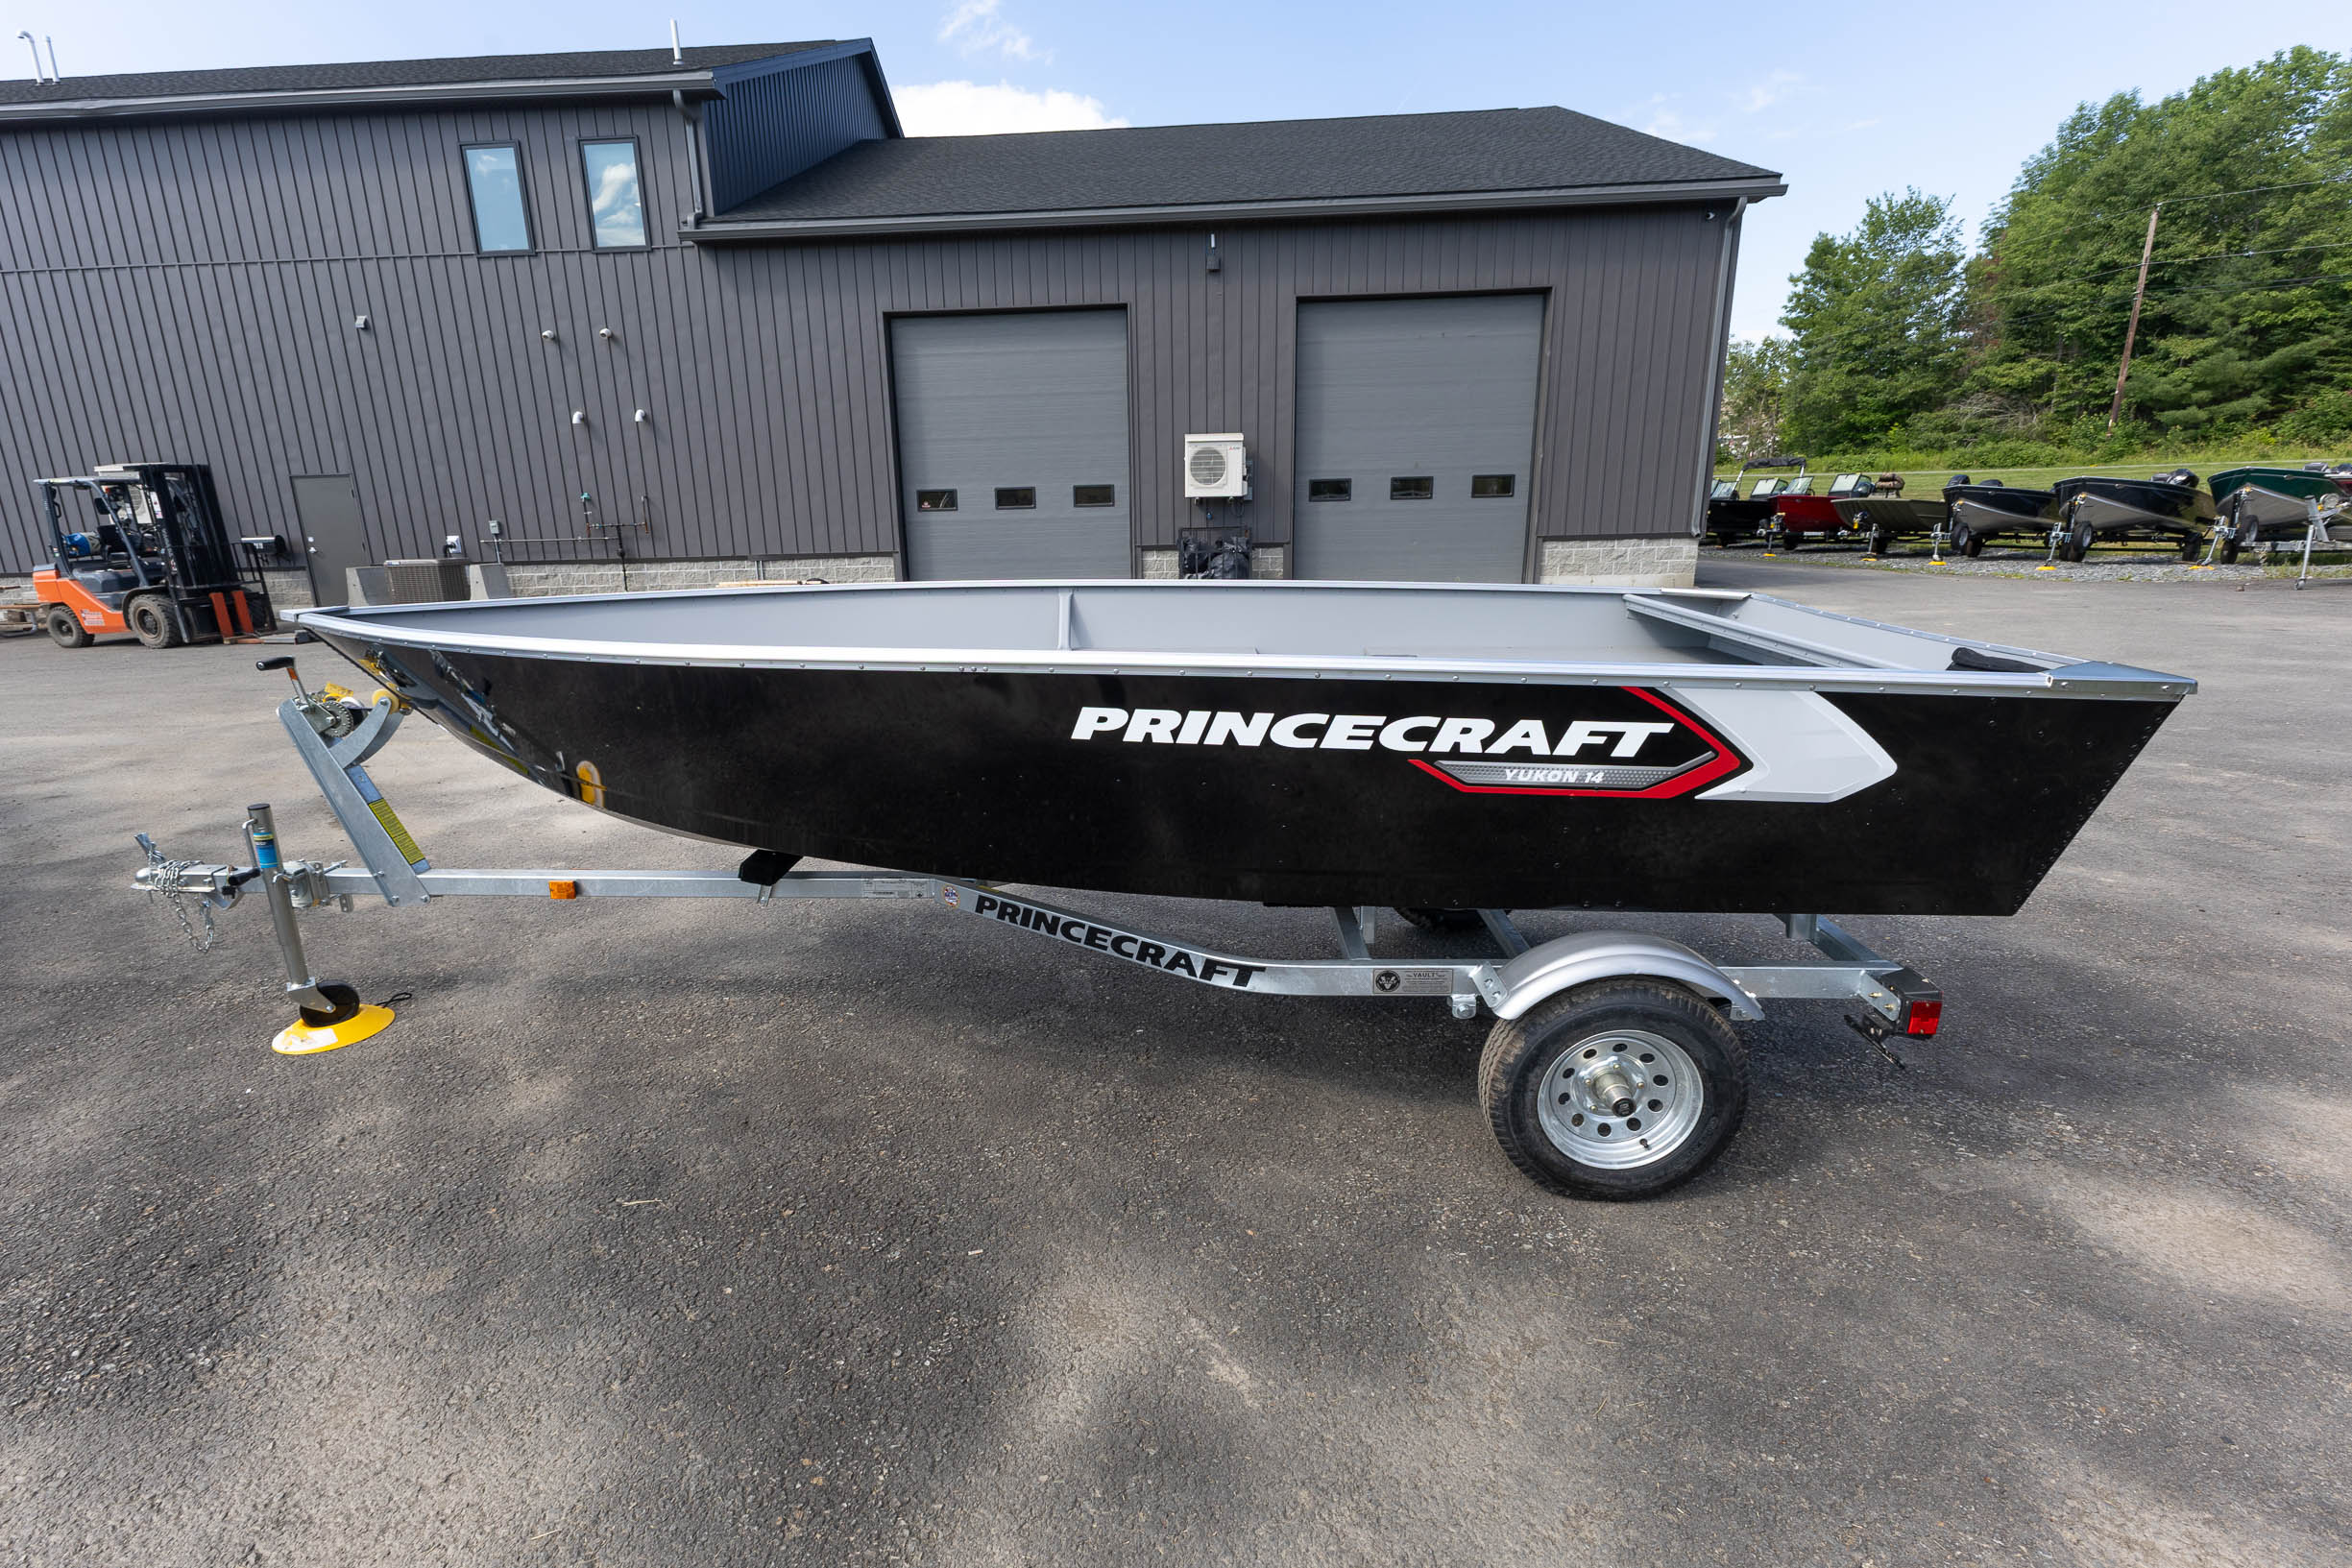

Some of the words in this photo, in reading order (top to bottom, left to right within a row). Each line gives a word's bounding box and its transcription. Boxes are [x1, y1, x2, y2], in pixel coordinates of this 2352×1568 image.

[1071, 707, 1674, 758] PRINCECRAFT
[1505, 768, 1579, 784] YUKON
[1584, 771, 1605, 784] 14
[975, 895, 1267, 988] PRINCECRAFT
